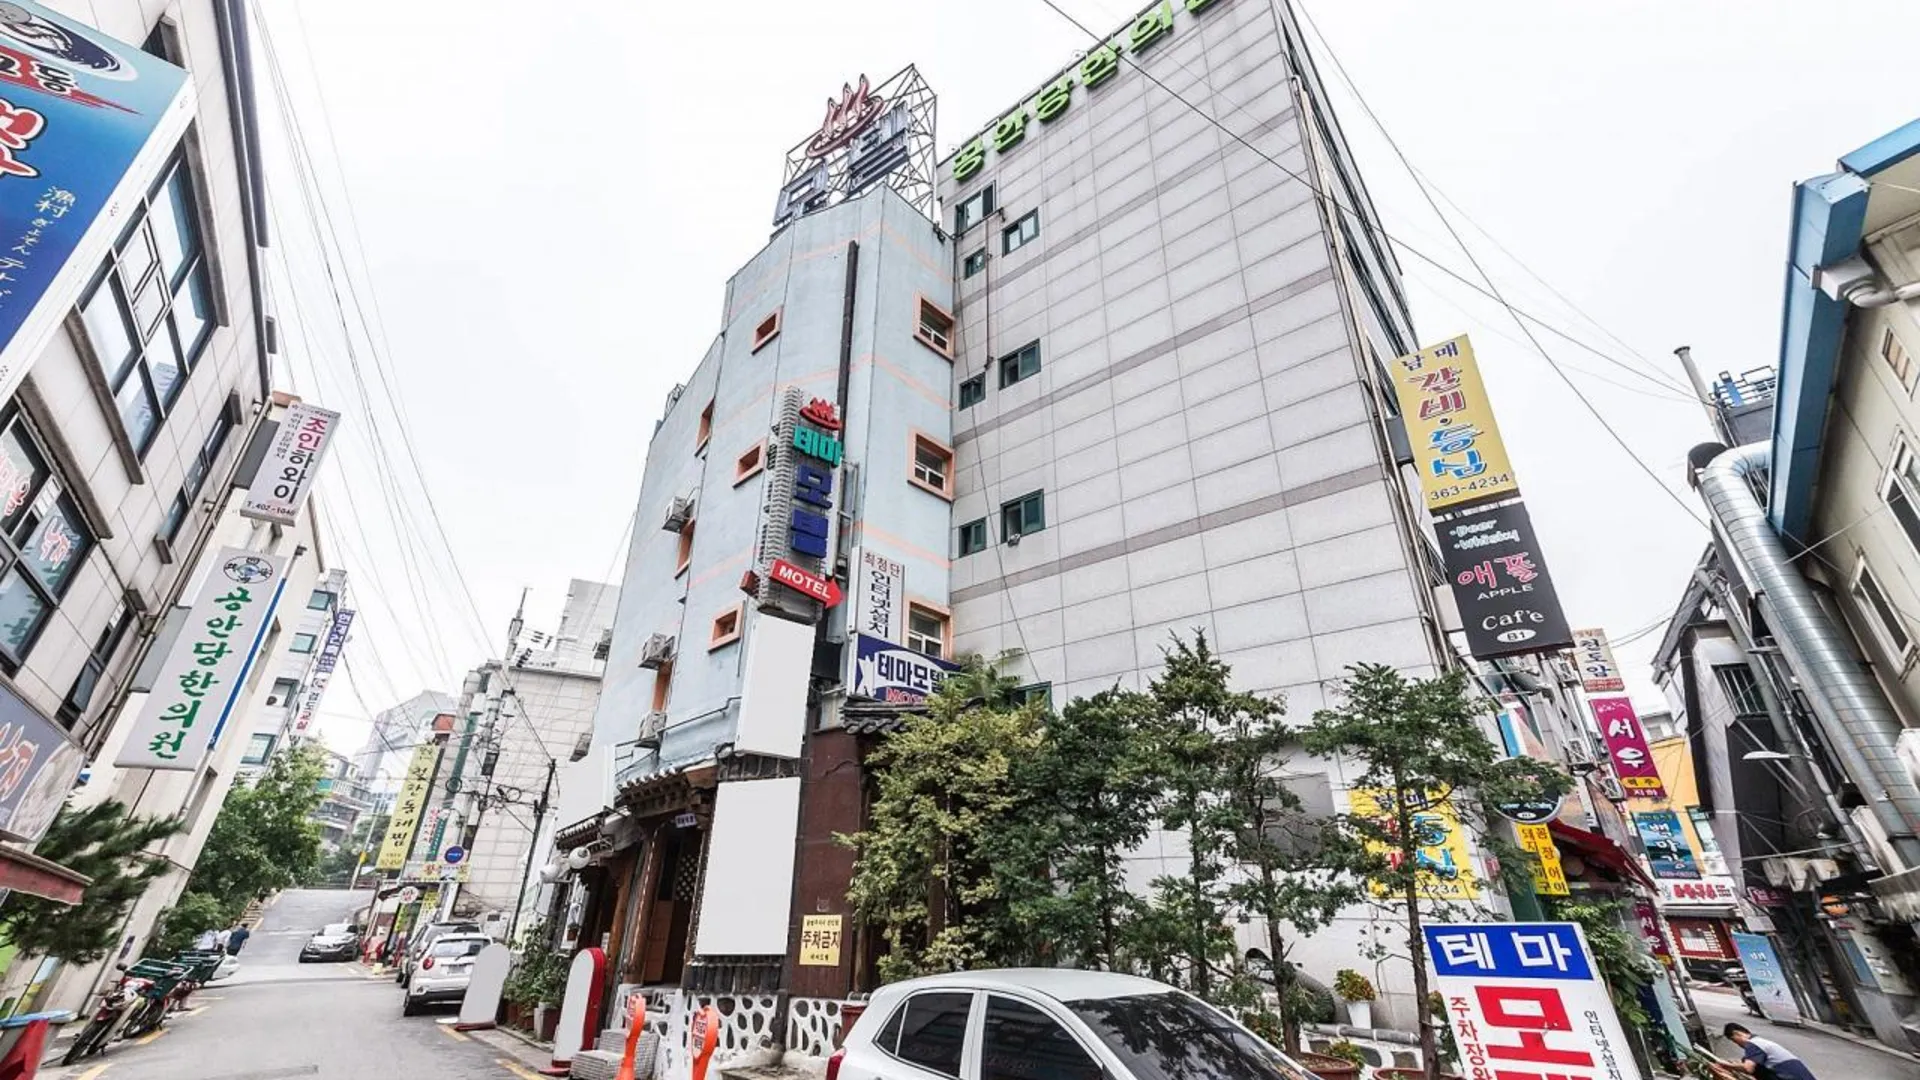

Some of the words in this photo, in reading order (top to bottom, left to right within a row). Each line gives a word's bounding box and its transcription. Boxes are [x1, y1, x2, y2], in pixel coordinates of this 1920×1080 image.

[1430, 473, 1510, 501] 363-4234
[778, 564, 832, 600] MOTEL
[1476, 583, 1535, 601] APPLE
[869, 570, 891, 638] 인터넷설치
[148, 586, 253, 759] 공안당한의원
[802, 929, 841, 949] 주차금지
[1435, 931, 1573, 972] 테마
